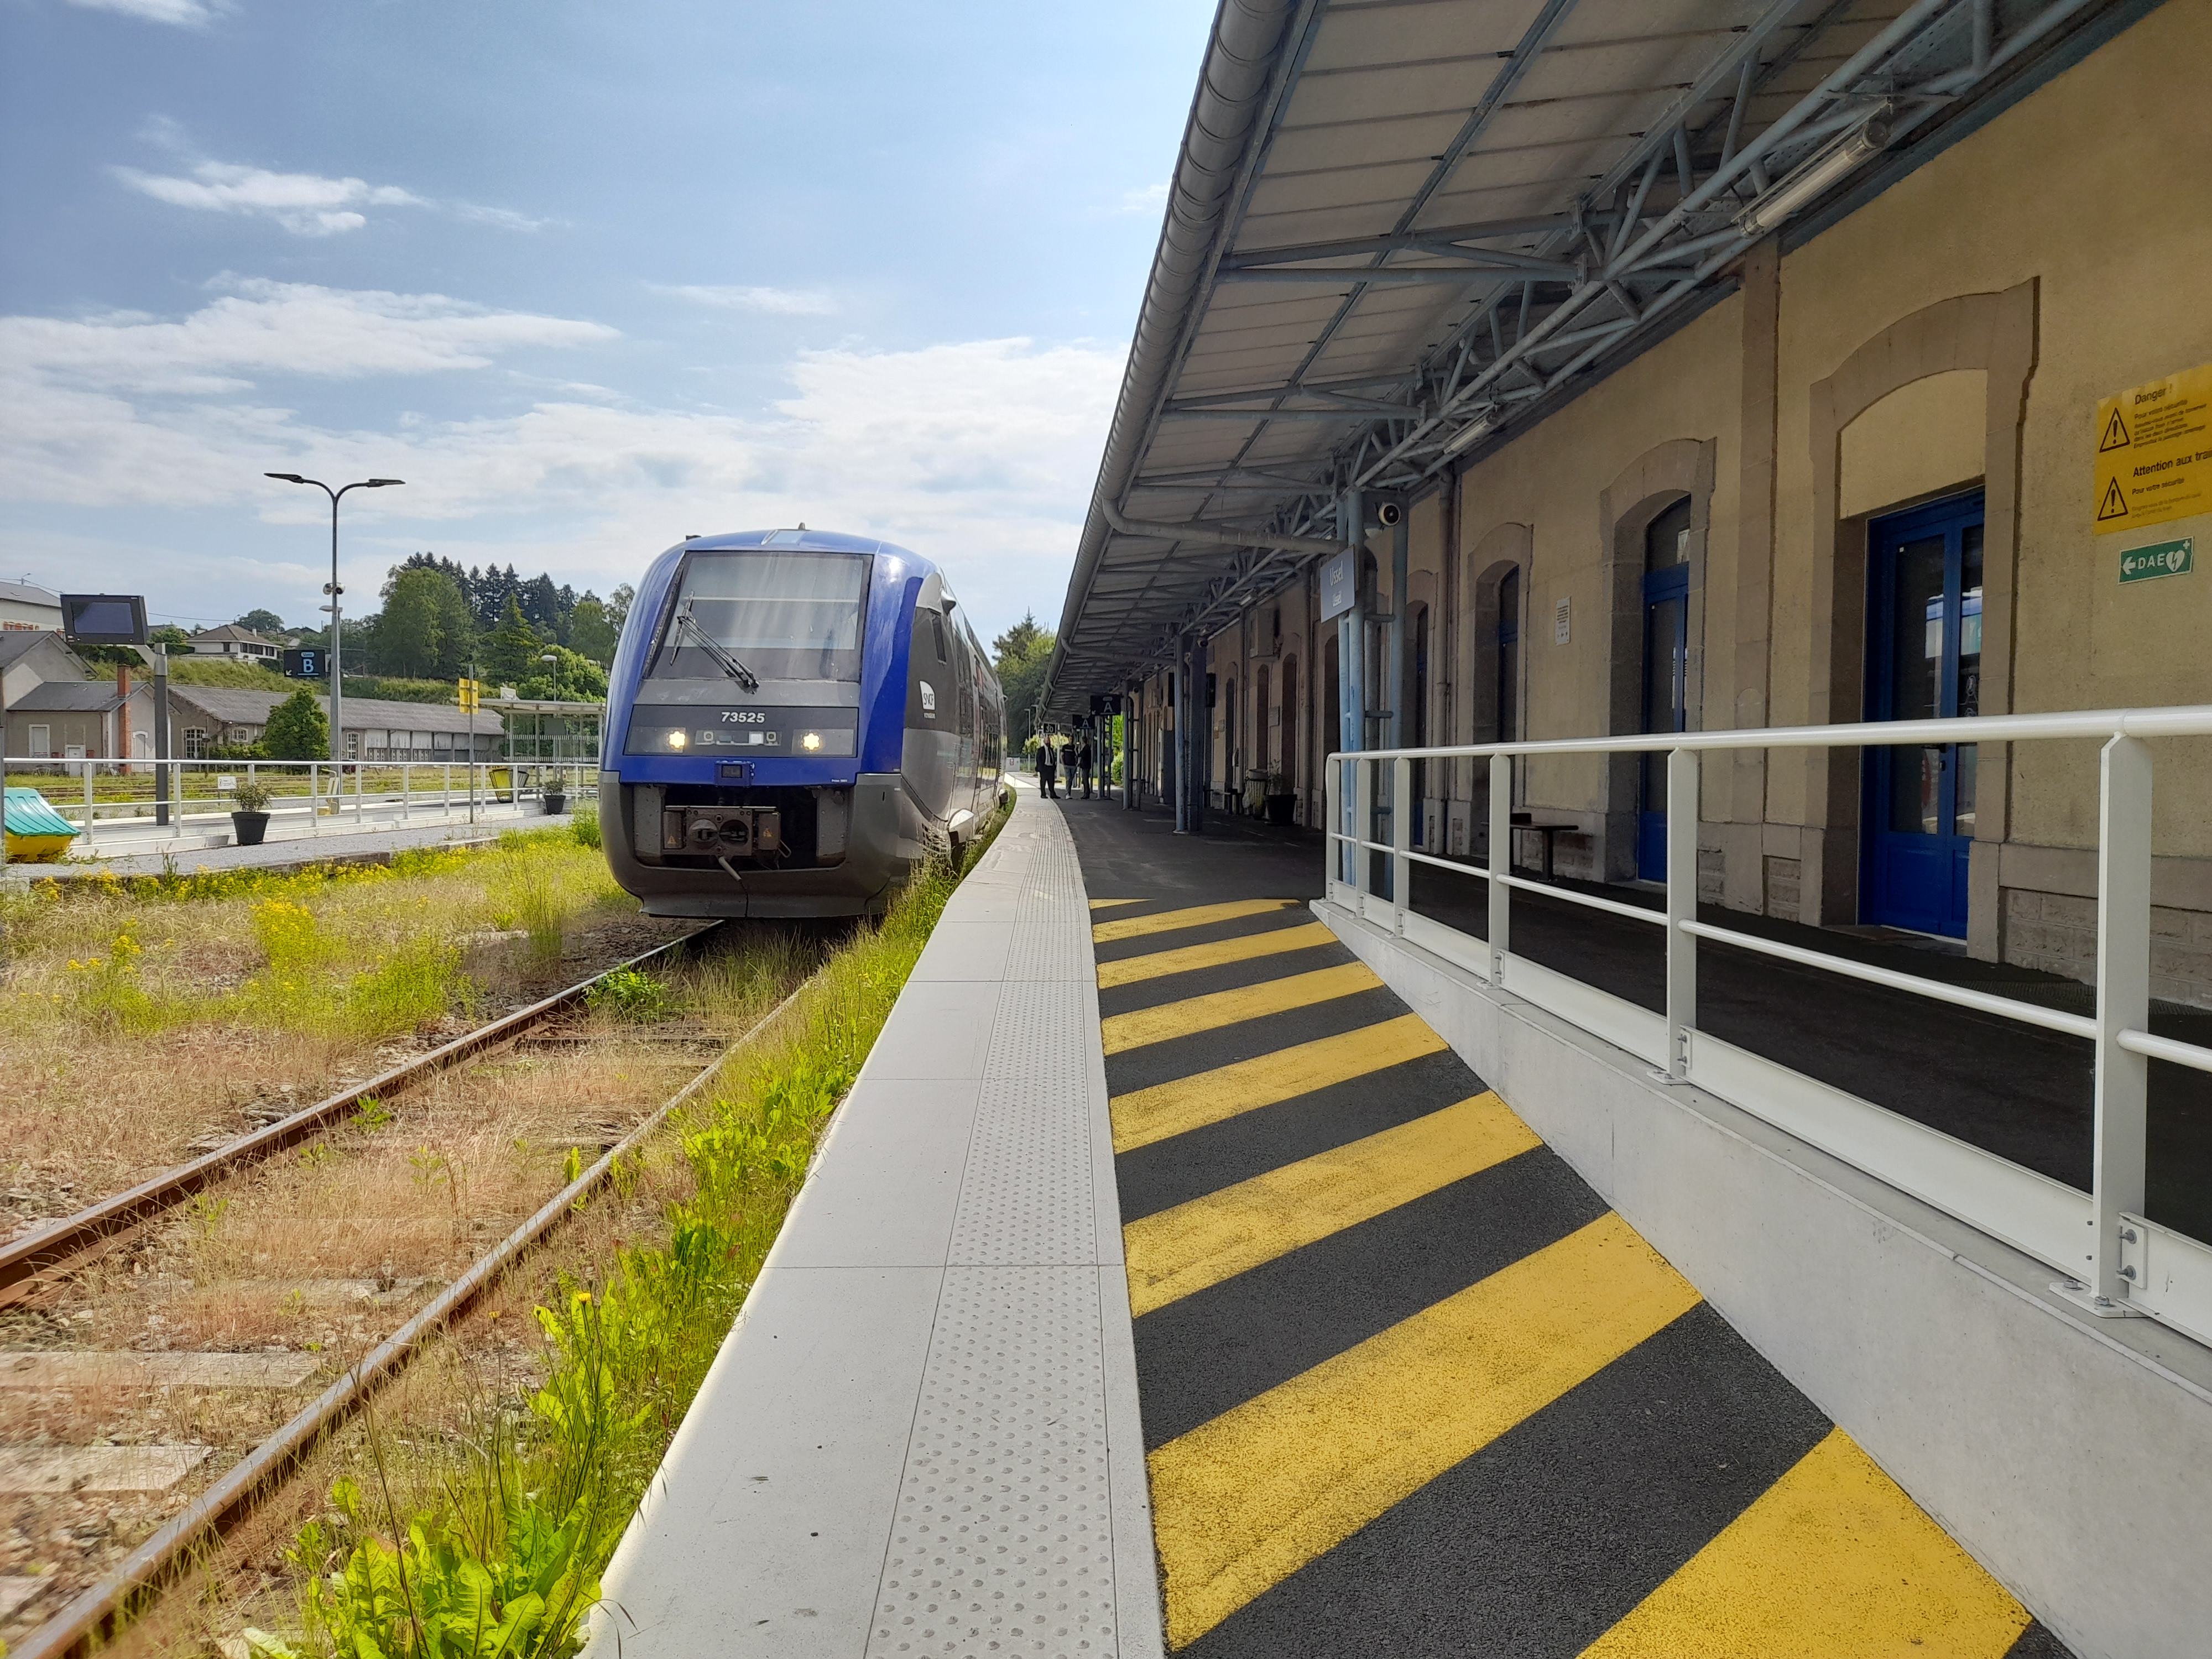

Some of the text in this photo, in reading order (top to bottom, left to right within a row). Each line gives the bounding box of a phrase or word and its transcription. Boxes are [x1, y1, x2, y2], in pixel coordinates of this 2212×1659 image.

[2135, 388, 2167, 405] Danger
[2133, 447, 2212, 477] Attention aux trai
[2137, 553, 2166, 570] DAE
[1329, 560, 1344, 586] Ussel
[303, 659, 314, 673] B
[1103, 702, 1113, 713] A
[721, 711, 766, 723] 73525
[1082, 719, 1089, 728] A
